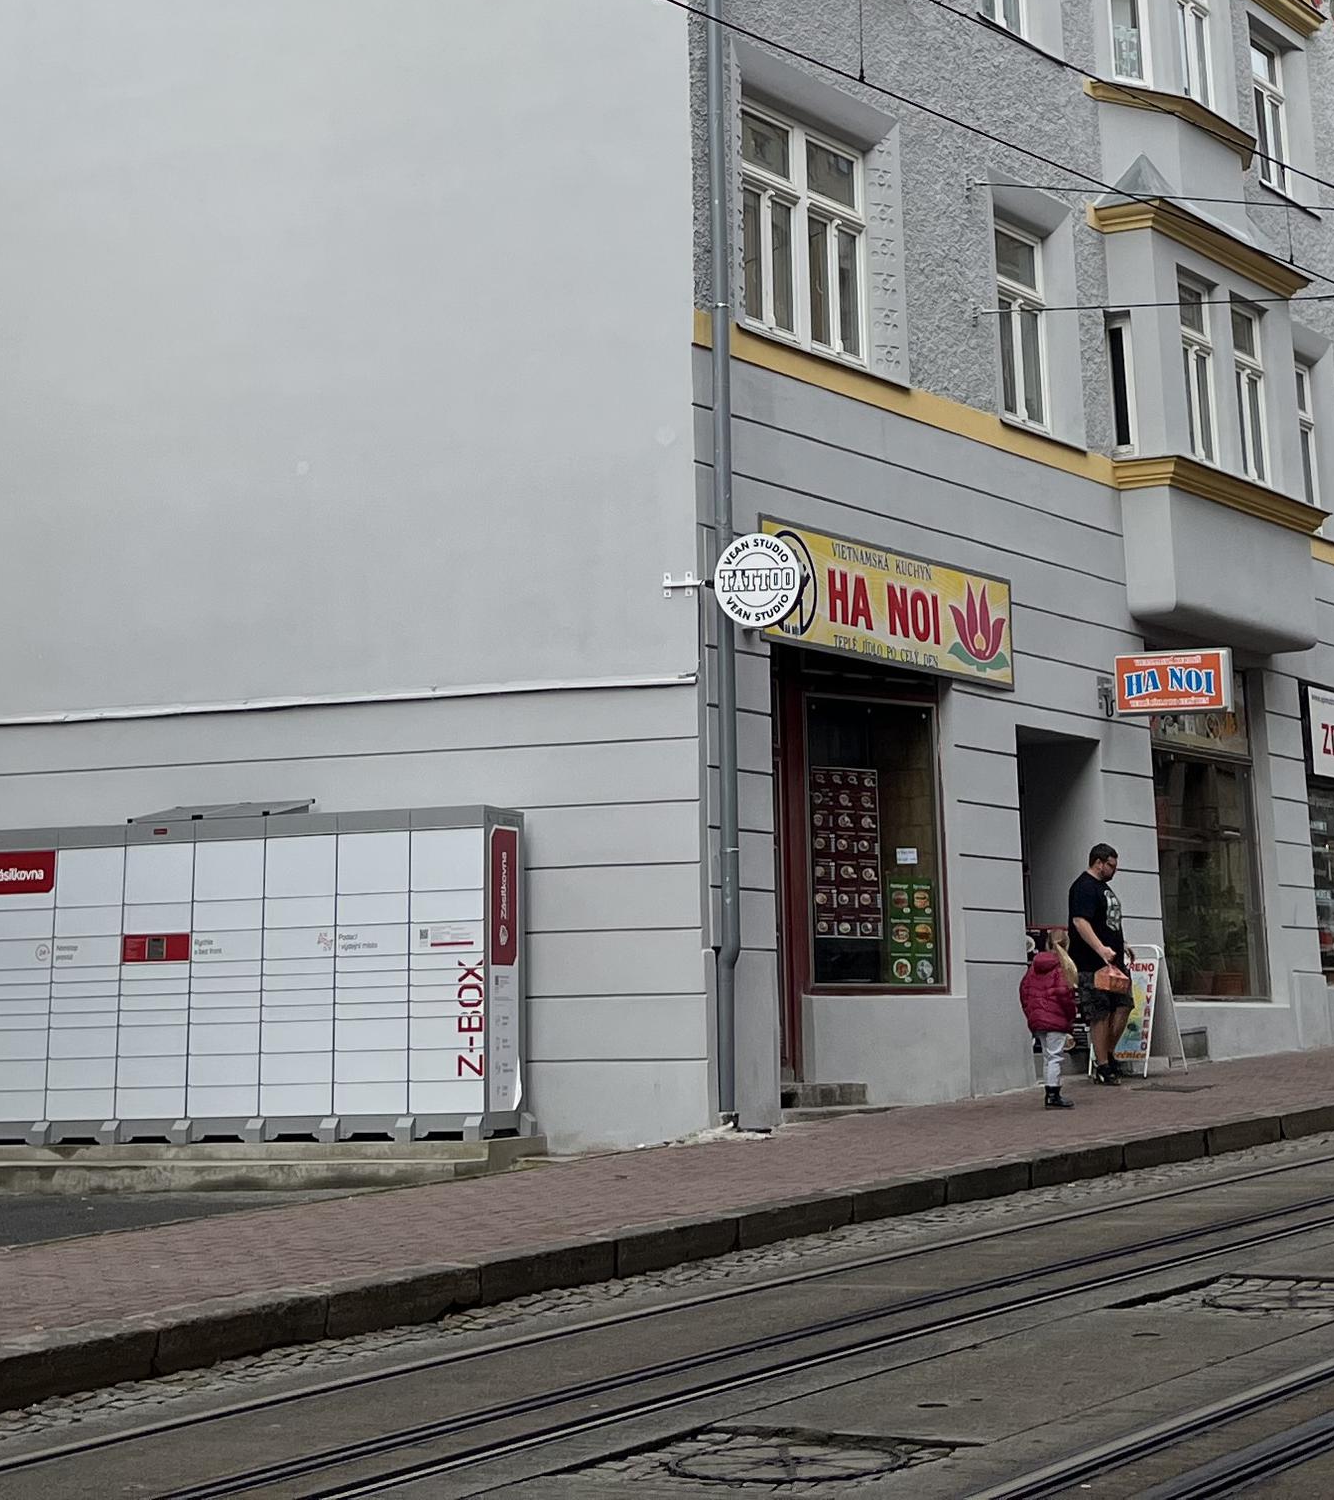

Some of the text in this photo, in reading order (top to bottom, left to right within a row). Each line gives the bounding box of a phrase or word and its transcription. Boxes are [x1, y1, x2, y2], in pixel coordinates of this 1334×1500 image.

[723, 538, 789, 565] VEAN STUDIO
[831, 541, 889, 571] VIETNAMSKÁ
[719, 567, 795, 593] TATTOO
[726, 594, 789, 622] VEAN STUDIO
[828, 567, 941, 646] HA NOI
[1124, 666, 1216, 699] HA NOI
[458, 960, 483, 1077] Z-BOX
